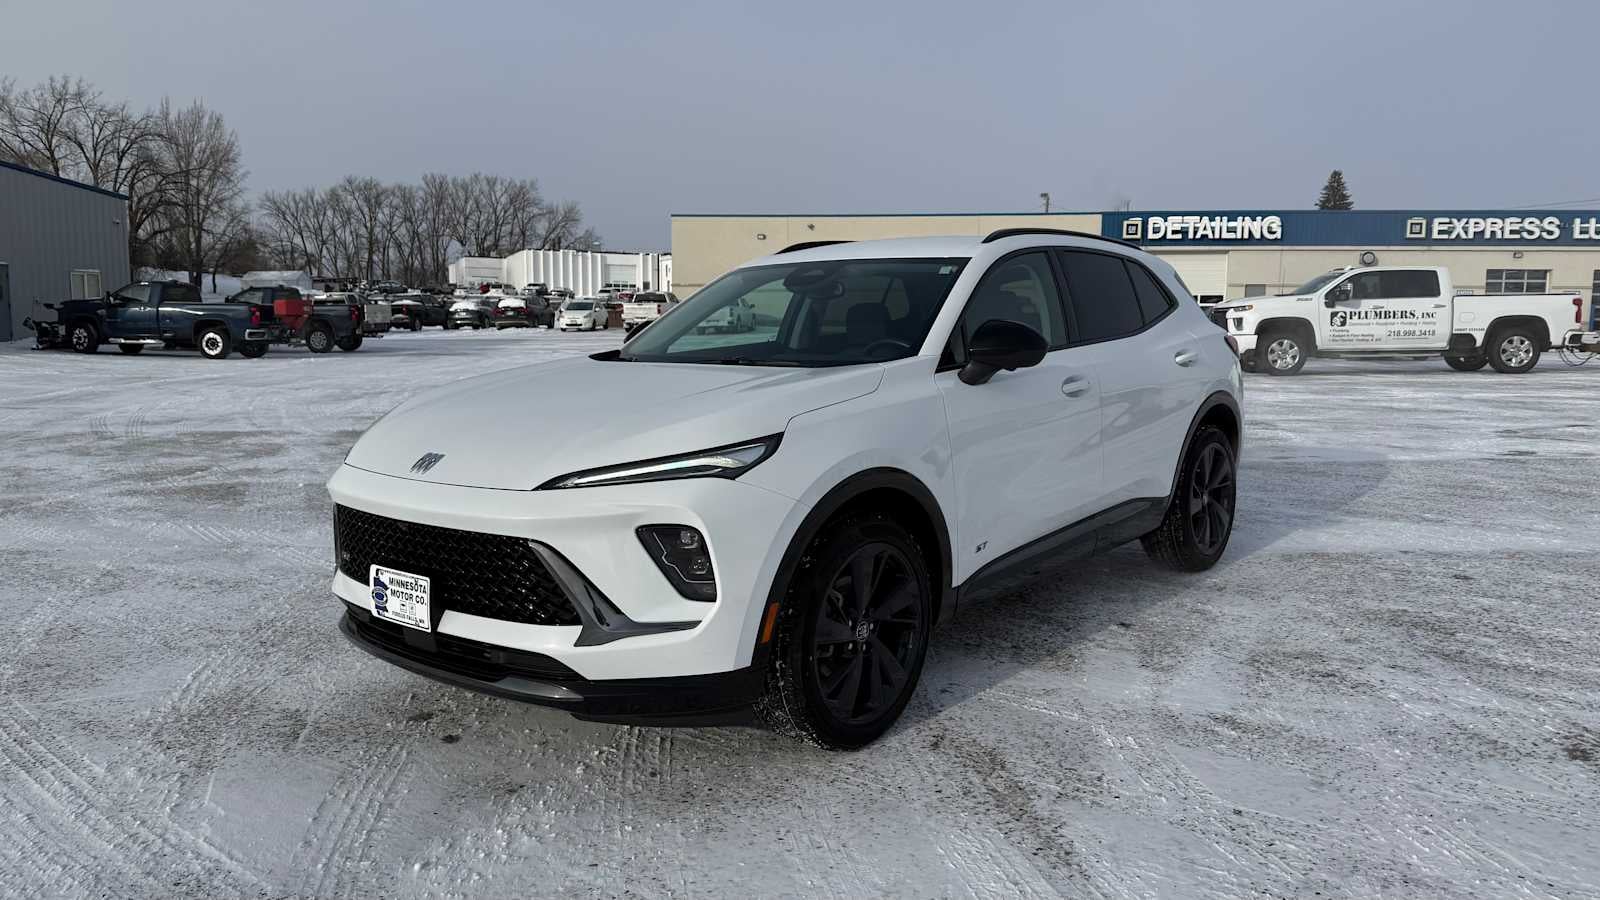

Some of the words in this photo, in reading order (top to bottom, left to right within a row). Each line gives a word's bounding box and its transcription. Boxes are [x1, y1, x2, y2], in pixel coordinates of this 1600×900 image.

[1147, 216, 1282, 240] DETAILING
[1431, 217, 1561, 240] EXPRESS
[1349, 310, 1419, 320] PLUMBERS,
[1421, 311, 1437, 319] INC
[389, 576, 427, 594] MINNESOTA
[390, 588, 414, 602] MOTOR
[415, 595, 427, 606] CO.
